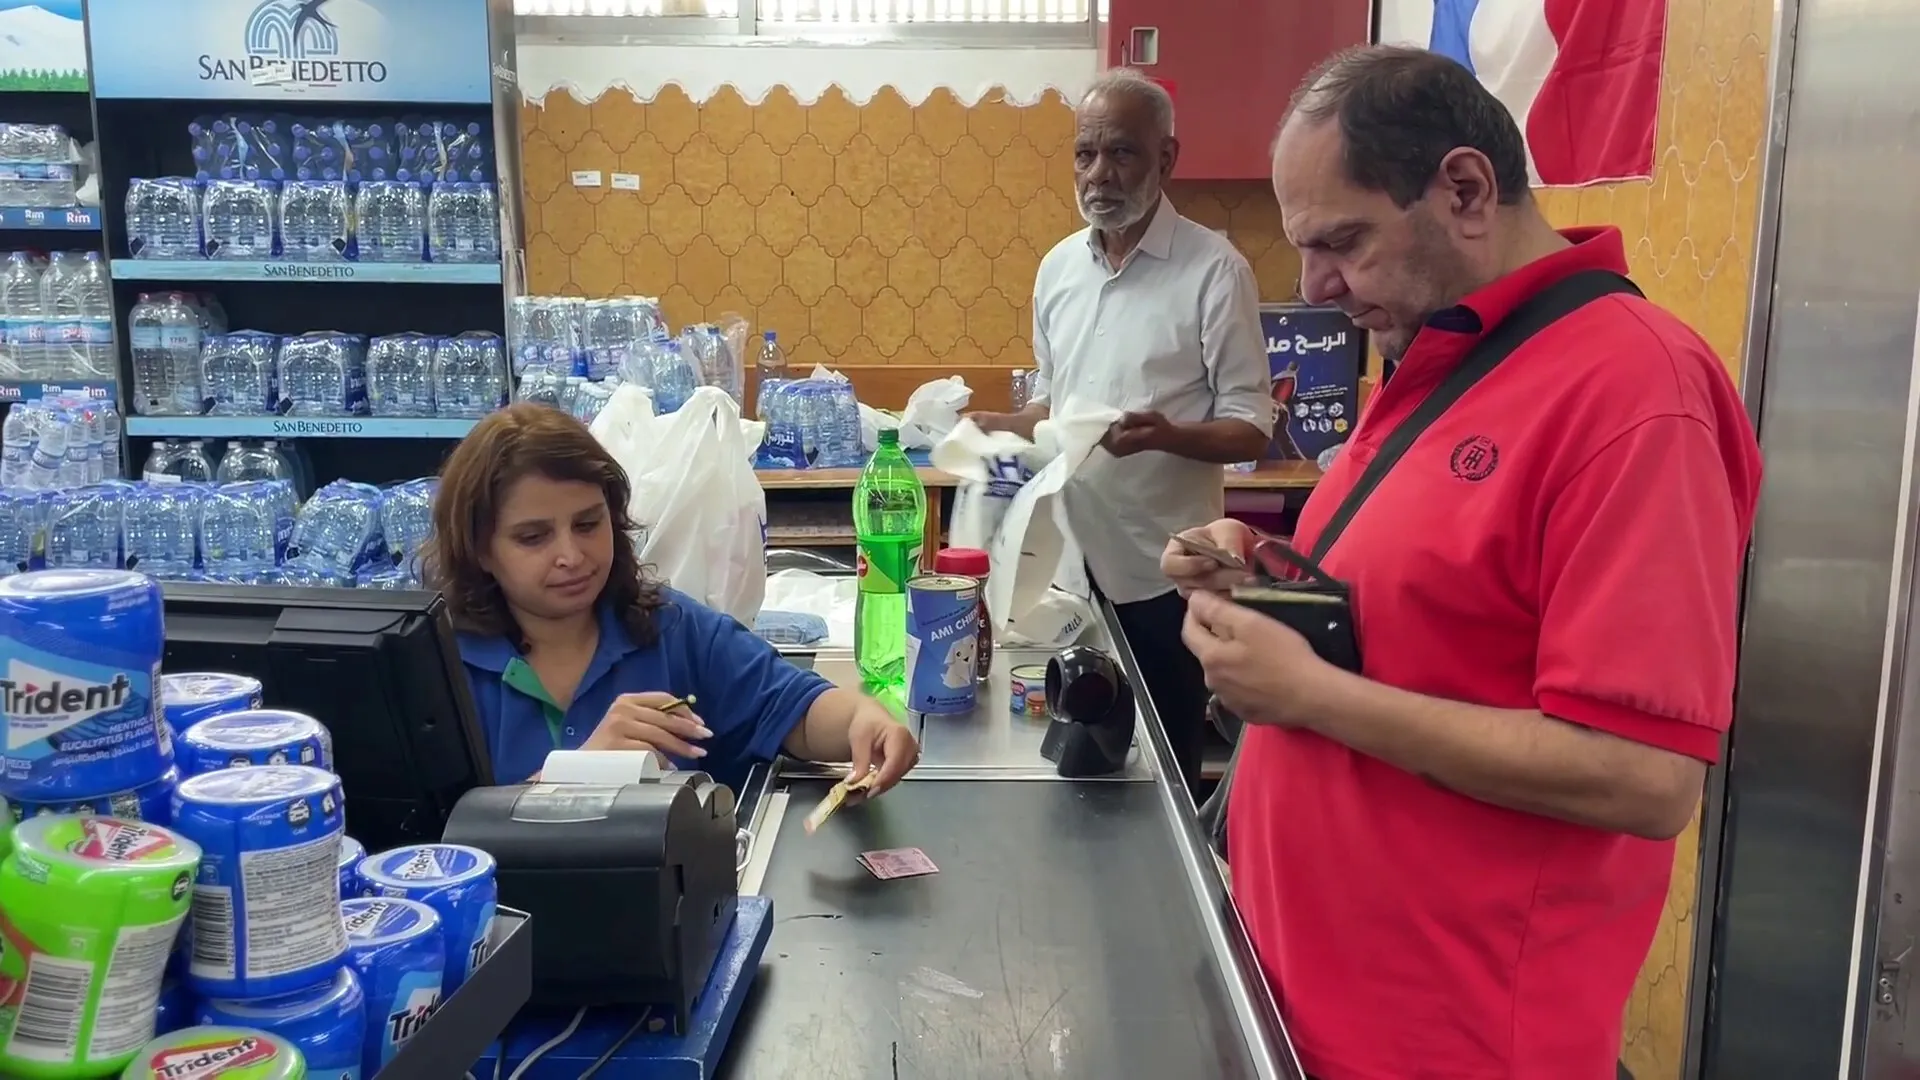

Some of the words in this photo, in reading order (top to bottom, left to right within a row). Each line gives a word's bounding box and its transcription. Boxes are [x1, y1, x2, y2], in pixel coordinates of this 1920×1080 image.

[66, 211, 92, 224] Rim
[41, 383, 62, 394] Rim
[930, 624, 955, 643] AMI
[0, 673, 131, 715] Trident
[61, 733, 124, 752] EUCALYPTUS
[105, 825, 148, 860] Trident
[404, 848, 433, 879] Trident
[344, 901, 387, 932] rident
[156, 1038, 258, 1077] Trident
